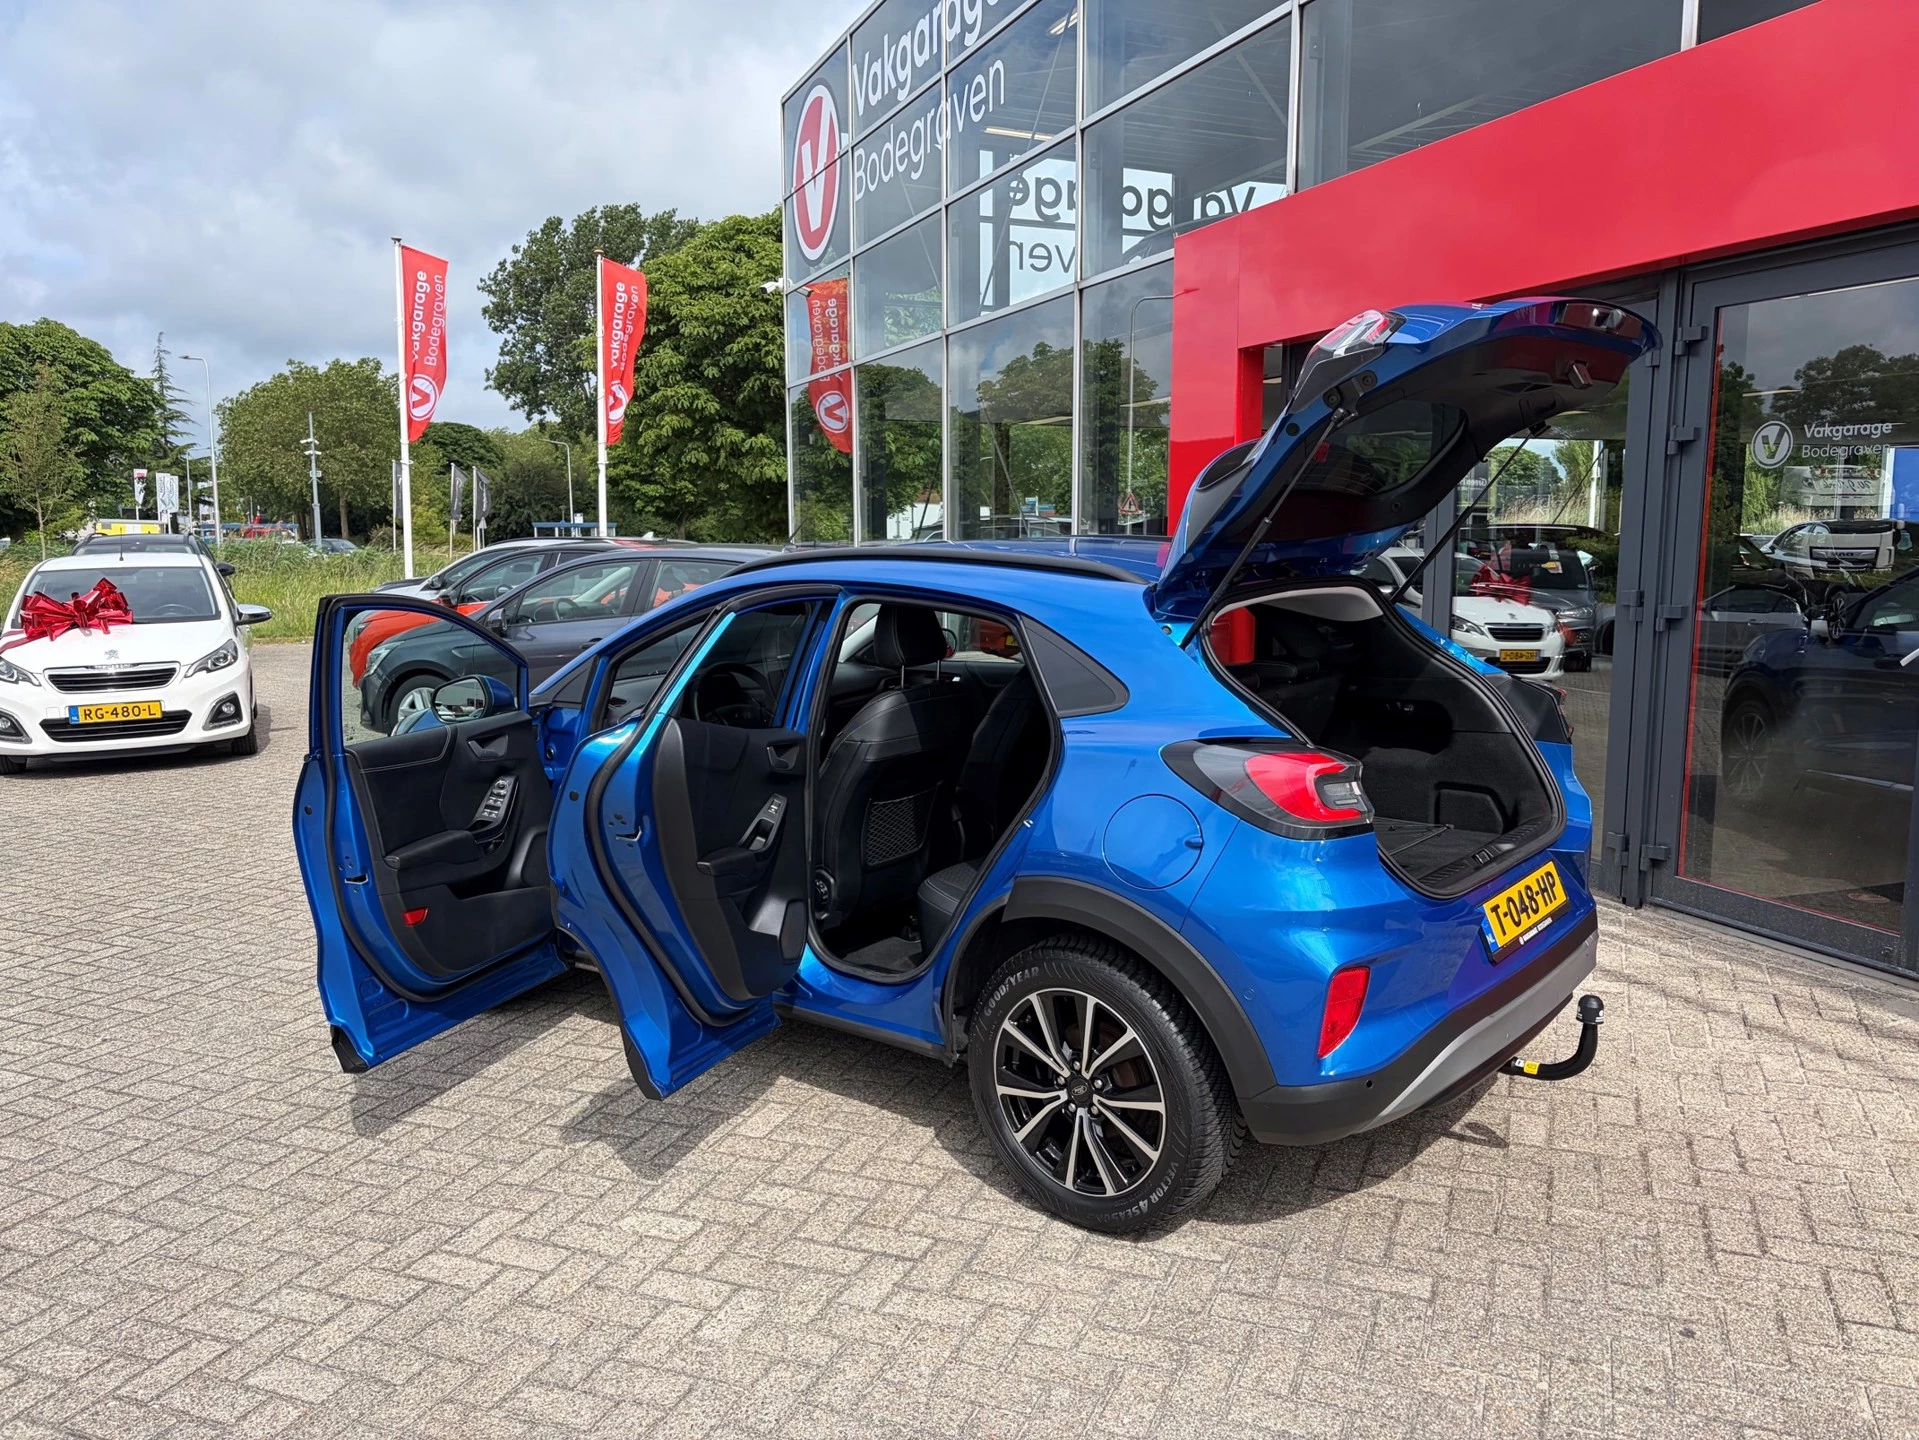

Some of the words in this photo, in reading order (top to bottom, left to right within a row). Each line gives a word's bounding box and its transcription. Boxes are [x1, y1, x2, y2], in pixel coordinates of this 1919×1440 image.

[853, 0, 999, 116] Vakgarag
[854, 59, 1005, 202] Bodegraven
[424, 274, 446, 367] Bodegraven
[1801, 443, 1892, 460] Bodegraven
[1803, 422, 1893, 441] Vakgarage
[83, 704, 157, 721] RG-480-L
[1490, 871, 1557, 937] T-048-HP
